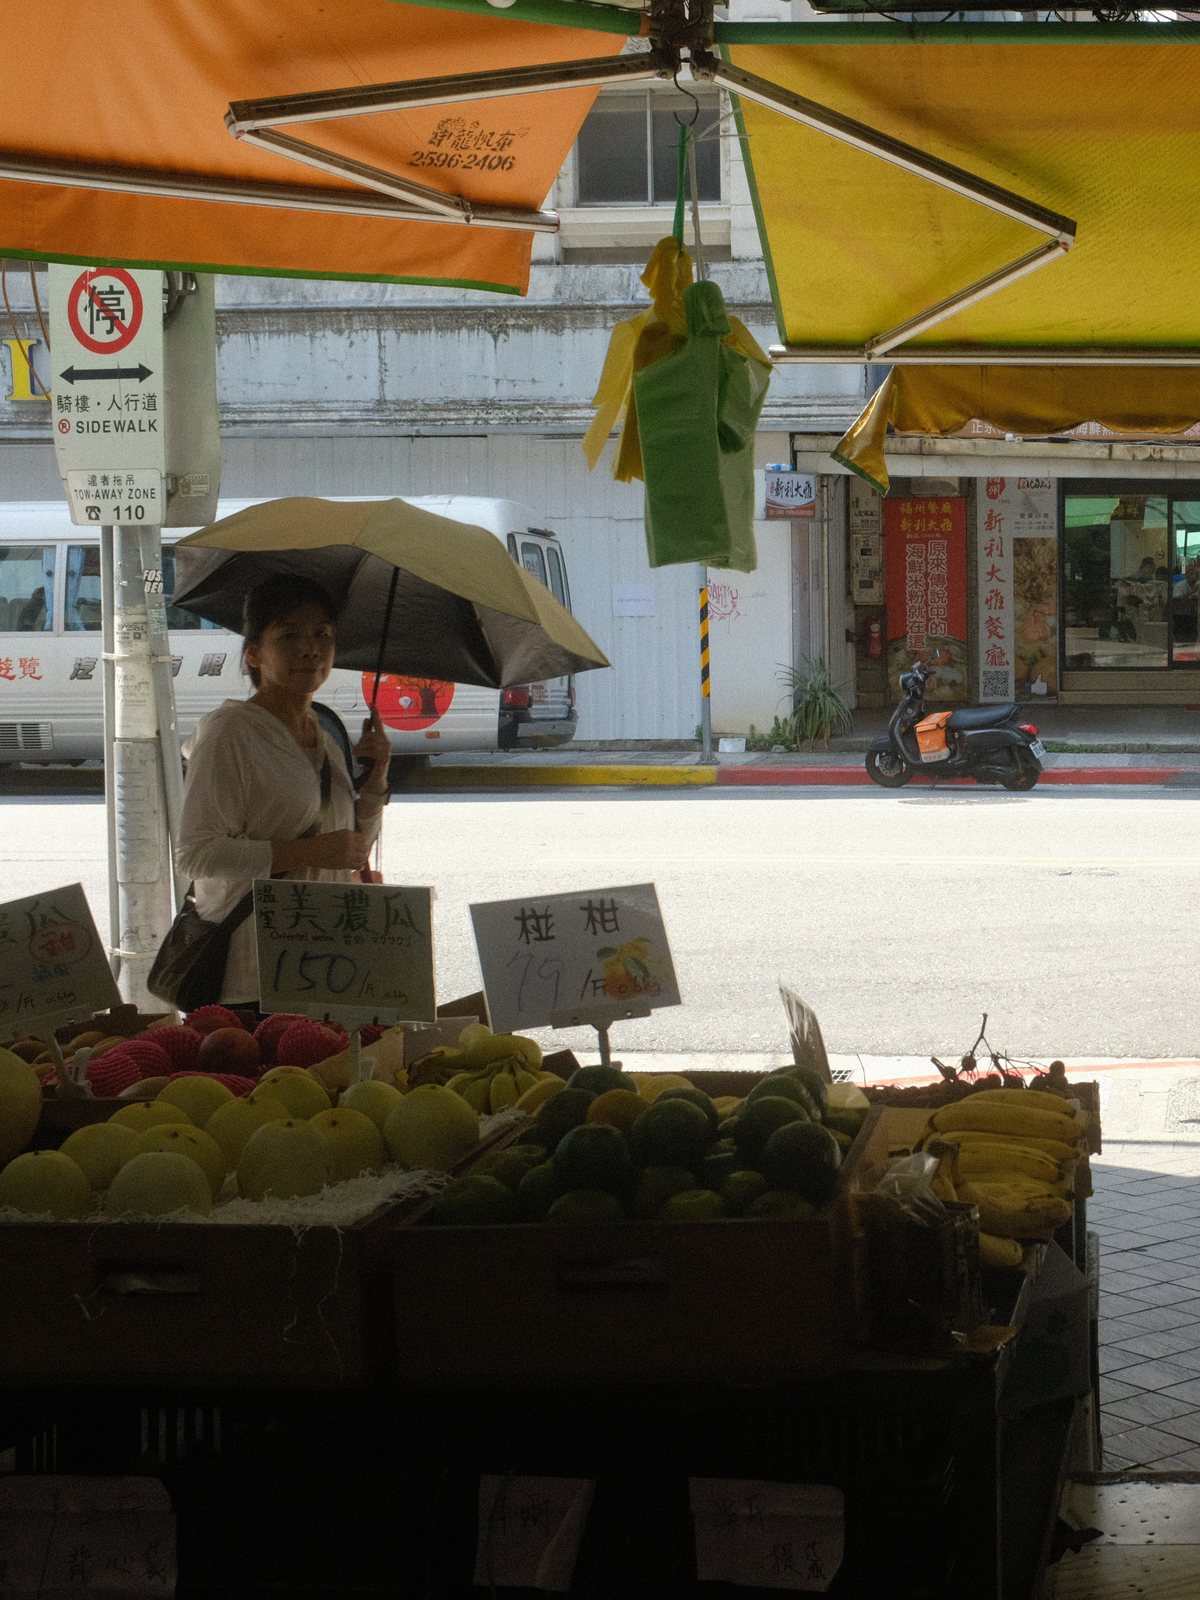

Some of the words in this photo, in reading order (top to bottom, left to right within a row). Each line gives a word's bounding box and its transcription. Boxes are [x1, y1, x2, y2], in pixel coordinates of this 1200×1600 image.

[84, 284, 126, 335] 停
[76, 419, 158, 434] SIDEWALK
[74, 489, 123, 500] TOW-AWAY
[128, 488, 157, 499] ZONE
[87, 474, 135, 487] 違者拖吊
[775, 478, 813, 499] 新利大雅
[113, 505, 145, 520] 110
[906, 544, 926, 650] 海鮮米粉就在這
[928, 540, 947, 637] 原來傳說中的
[983, 508, 1010, 667] 新利大雅餐廳
[282, 884, 425, 937] 美濃瓜
[273, 949, 357, 994] 150
